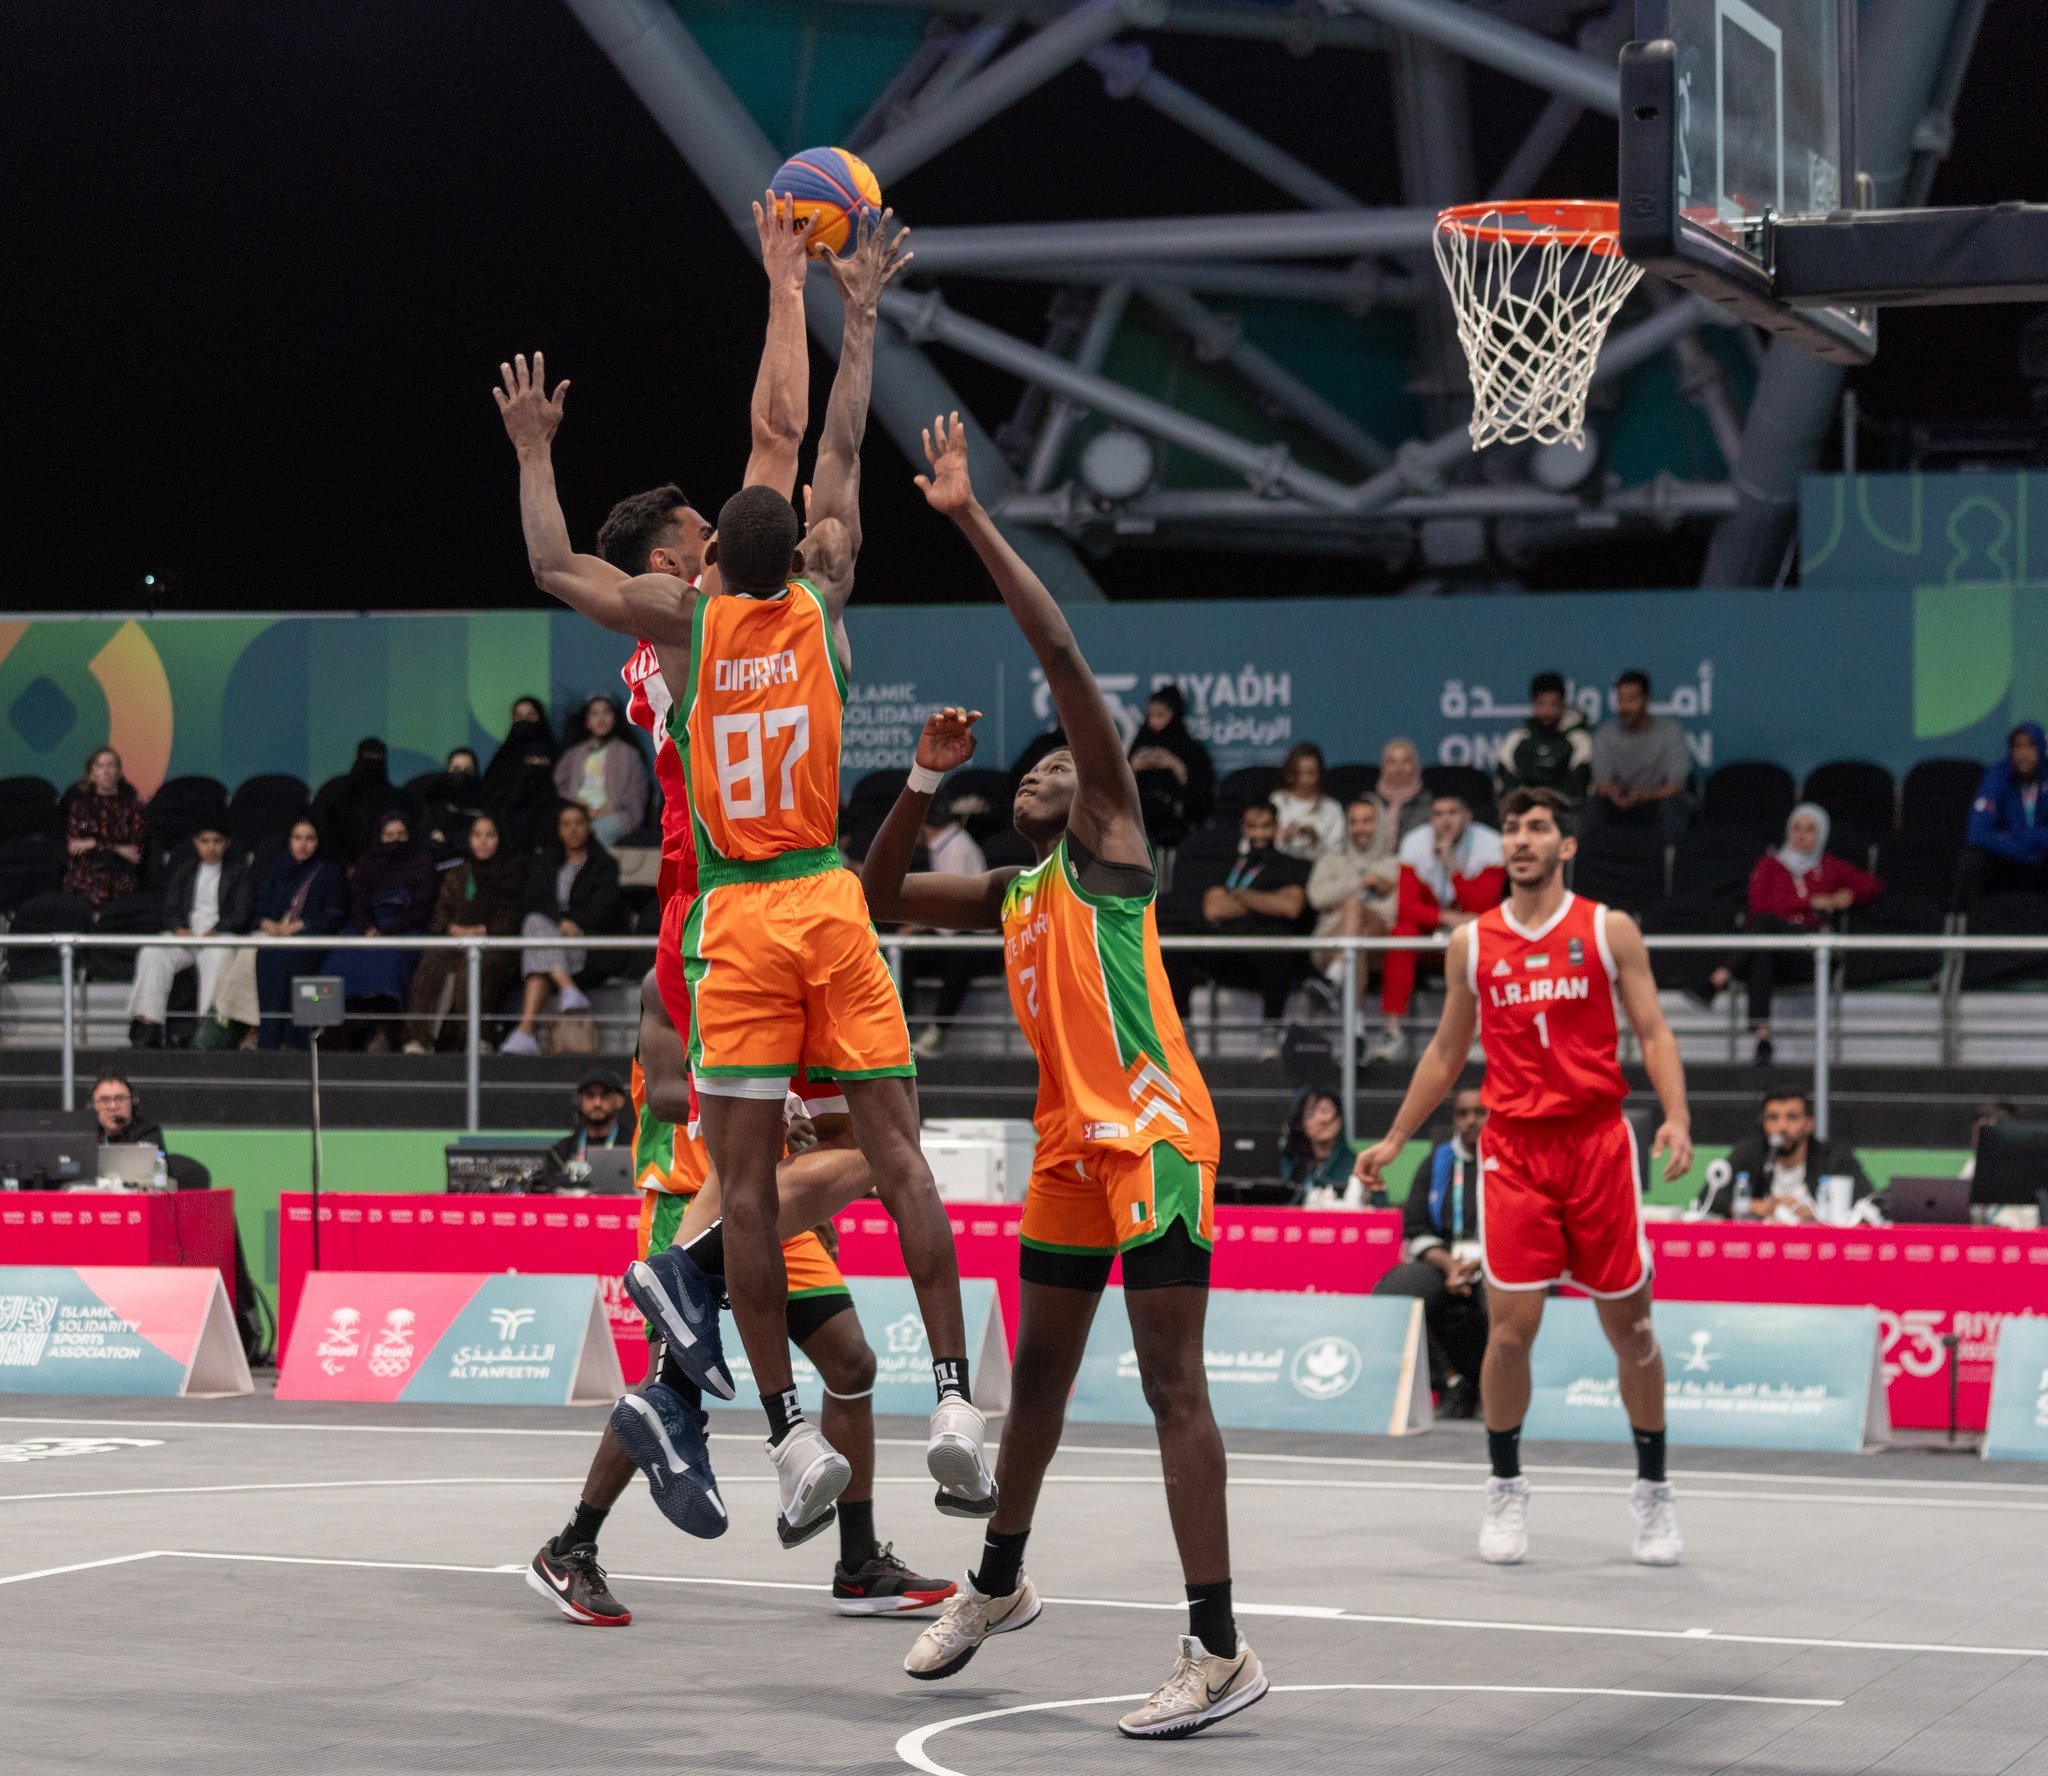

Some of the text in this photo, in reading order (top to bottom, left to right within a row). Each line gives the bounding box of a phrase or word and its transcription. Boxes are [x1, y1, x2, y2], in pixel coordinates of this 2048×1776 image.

[715, 649, 799, 691] DIARRA
[713, 704, 810, 820] 87
[1533, 1011, 1550, 1049] 1
[61, 1306, 116, 1319] ISLAMIC
[58, 1320, 141, 1333] SOLIDARITY
[53, 1333, 105, 1346] SPORTS
[50, 1347, 141, 1359] ASSOCIATION
[449, 1365, 550, 1379] ALTANFEETHI
